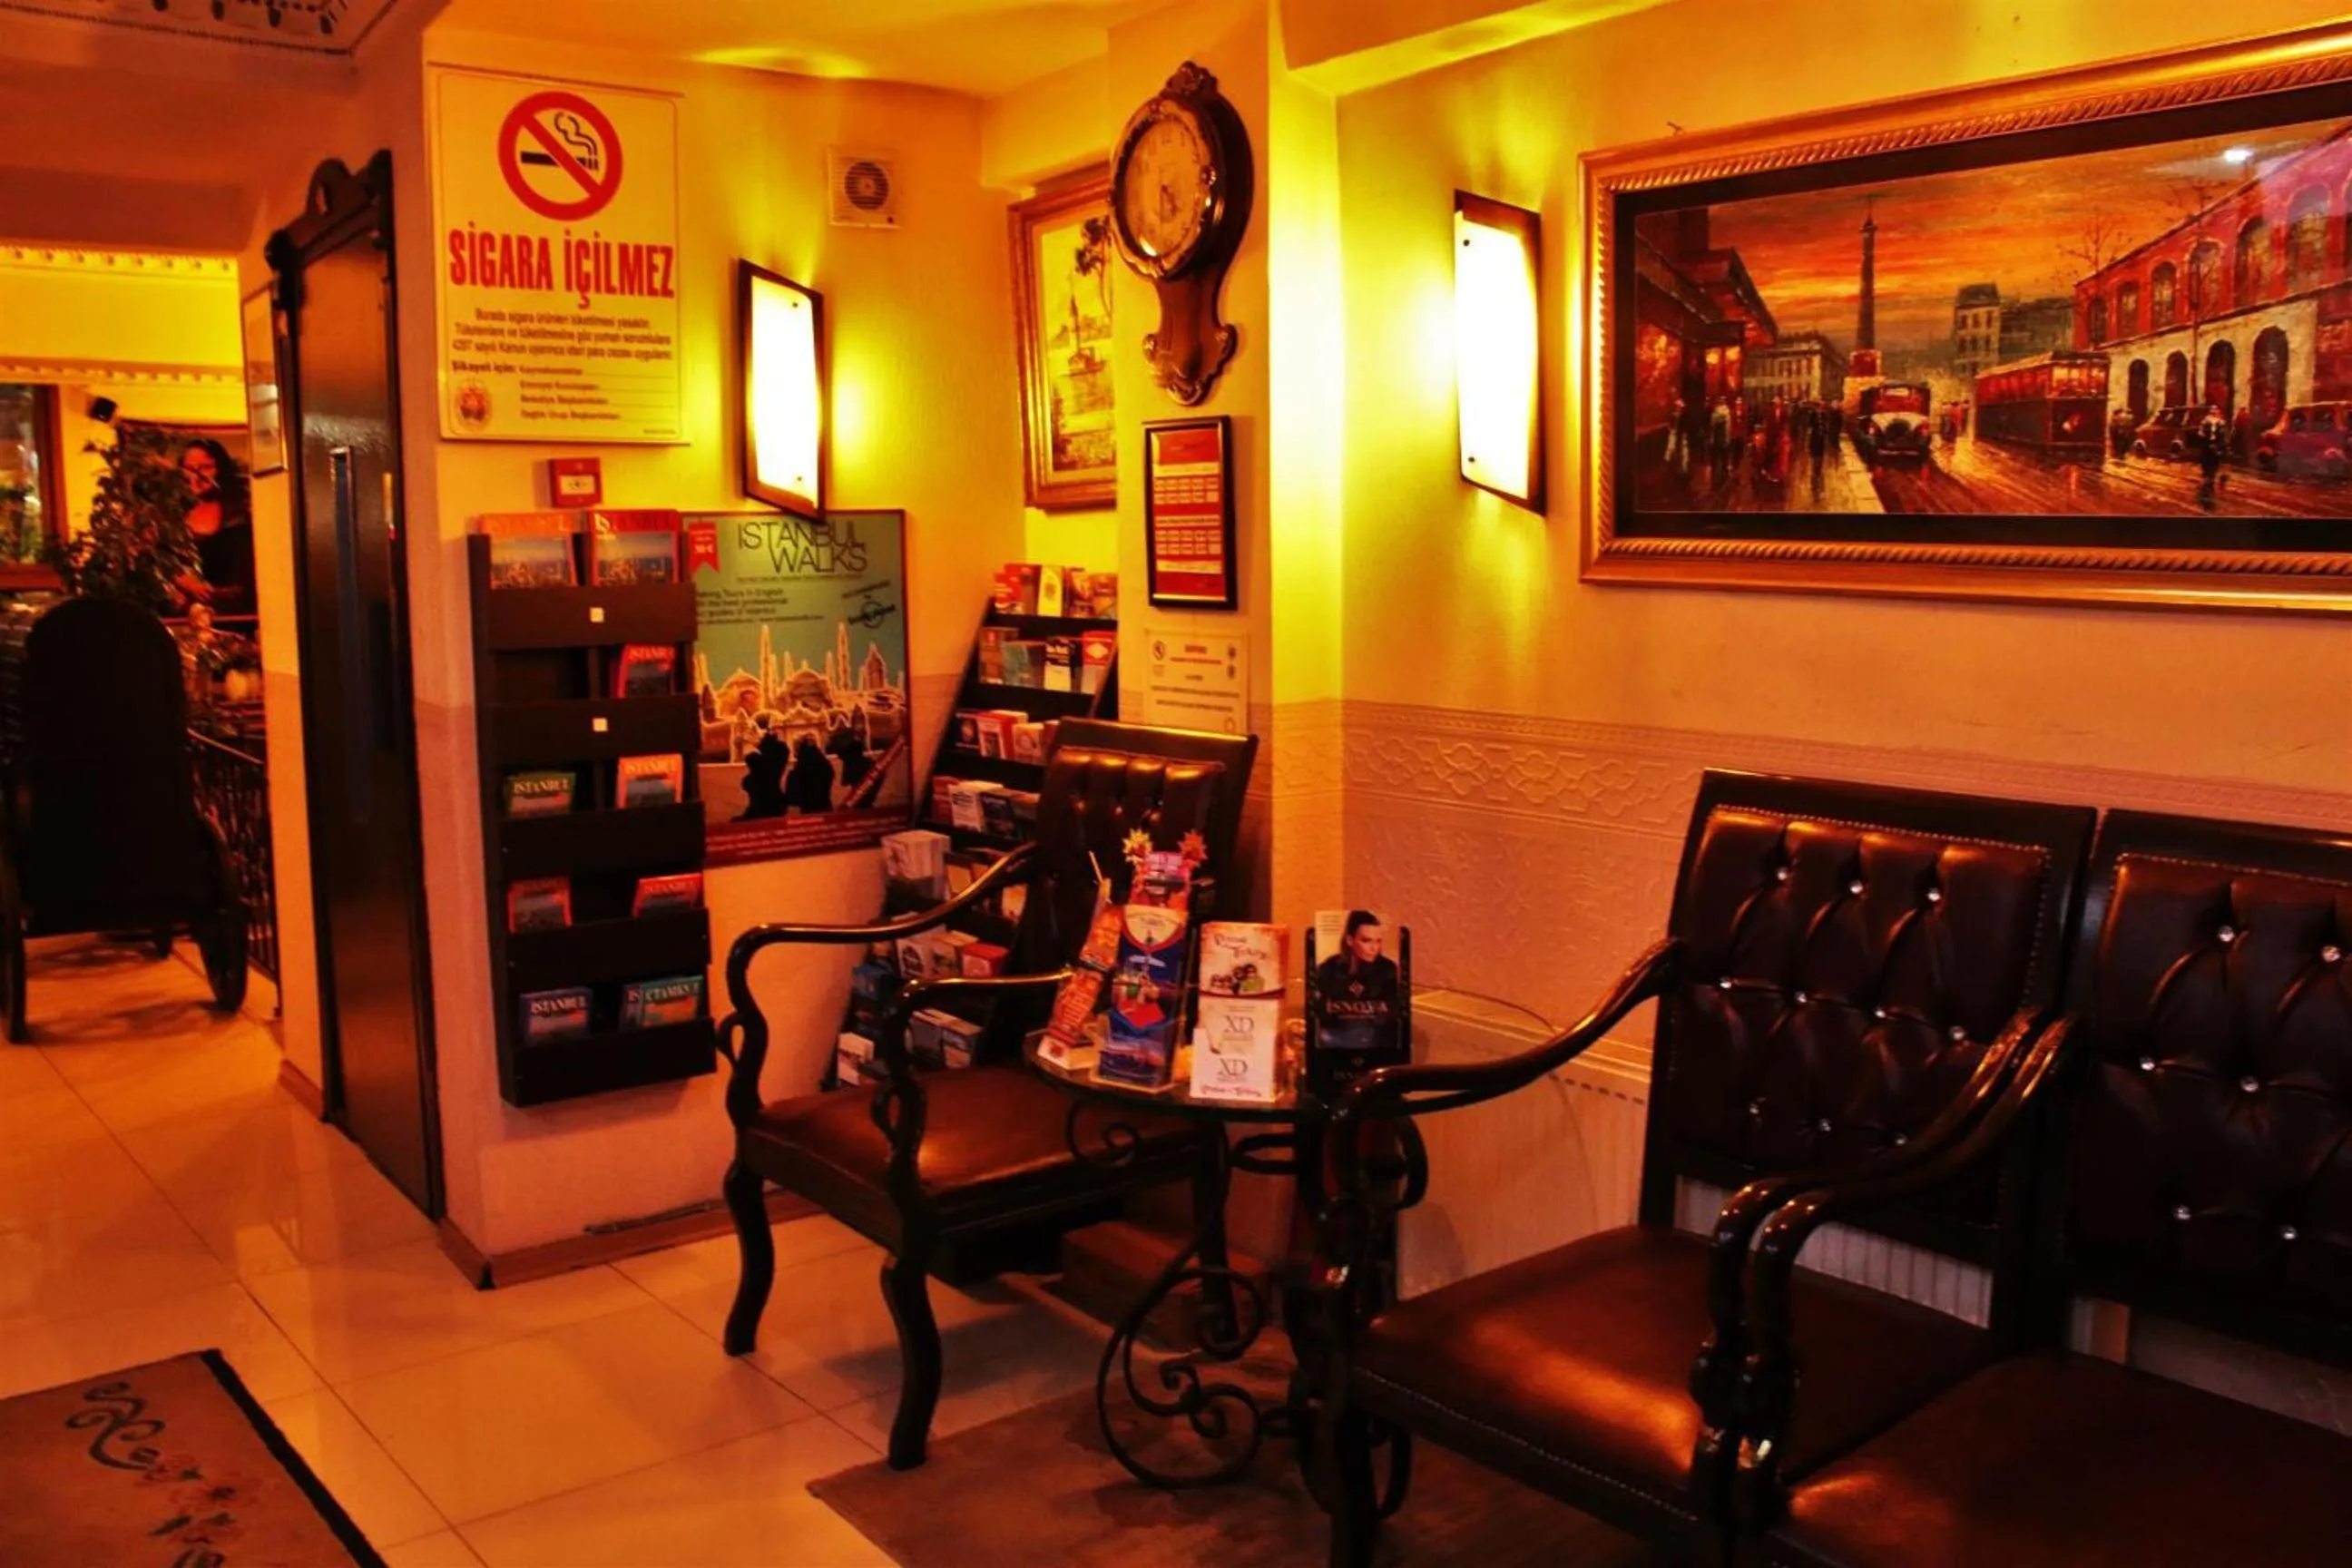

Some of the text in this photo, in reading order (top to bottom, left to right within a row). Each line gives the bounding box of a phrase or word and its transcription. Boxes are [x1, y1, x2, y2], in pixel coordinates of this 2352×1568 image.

[449, 220, 675, 309] SİGARA İÇİLMEZ
[738, 521, 865, 550] ISTANBUL
[769, 544, 868, 573] WALKS
